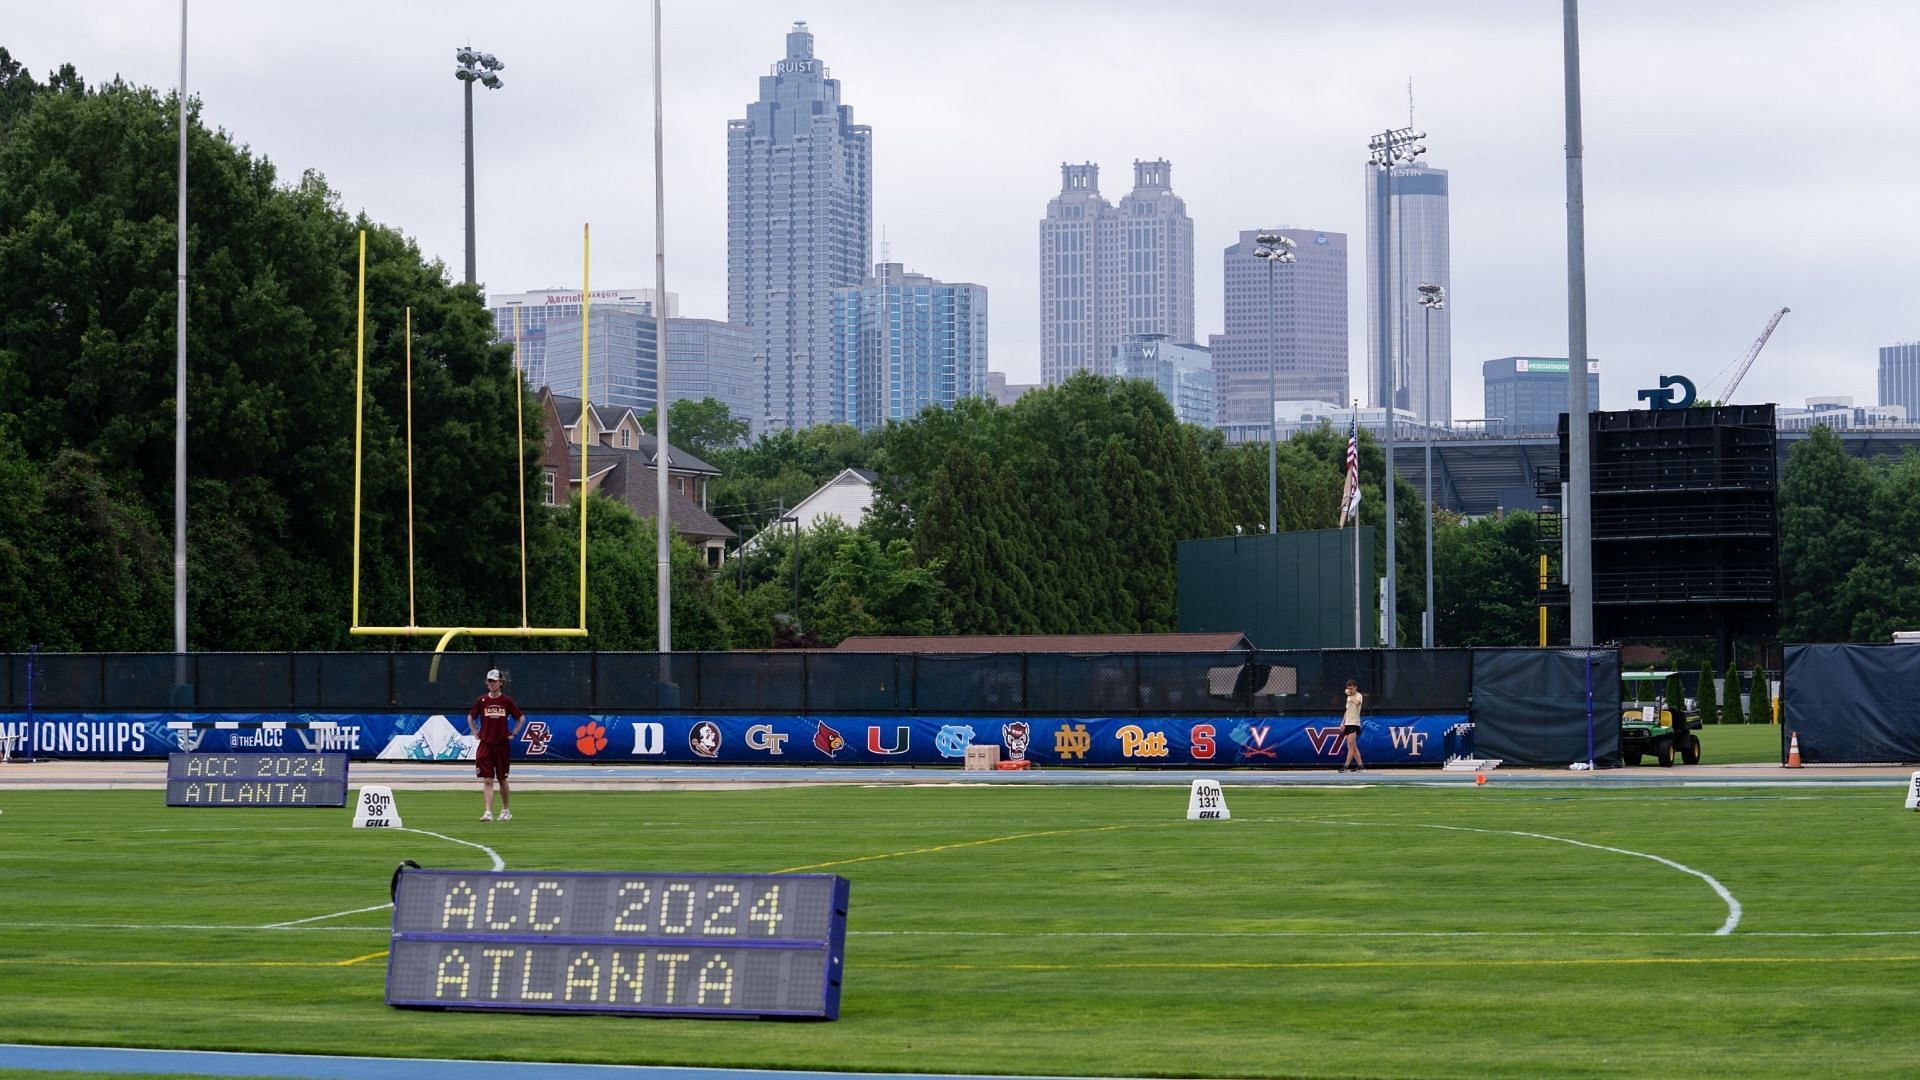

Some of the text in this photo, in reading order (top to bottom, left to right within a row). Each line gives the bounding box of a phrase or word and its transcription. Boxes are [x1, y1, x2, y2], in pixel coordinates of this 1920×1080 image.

[771, 61, 813, 73] RUIST
[1142, 348, 1156, 358] W
[632, 722, 664, 754] D
[745, 724, 788, 755] GT
[867, 726, 910, 754] U
[1115, 724, 1169, 757] Pitt
[1190, 724, 1216, 760] S
[1388, 726, 1428, 756] WF
[187, 757, 326, 777] ACC 2024
[185, 783, 307, 803] ATLANTA
[364, 792, 390, 804] 30m
[1196, 786, 1220, 796] 40m
[368, 804, 386, 816] 98'
[1199, 797, 1218, 808] 131'
[366, 819, 390, 827] GILL
[442, 881, 784, 936] ACC 2024
[435, 949, 734, 1005] ATLANTA
